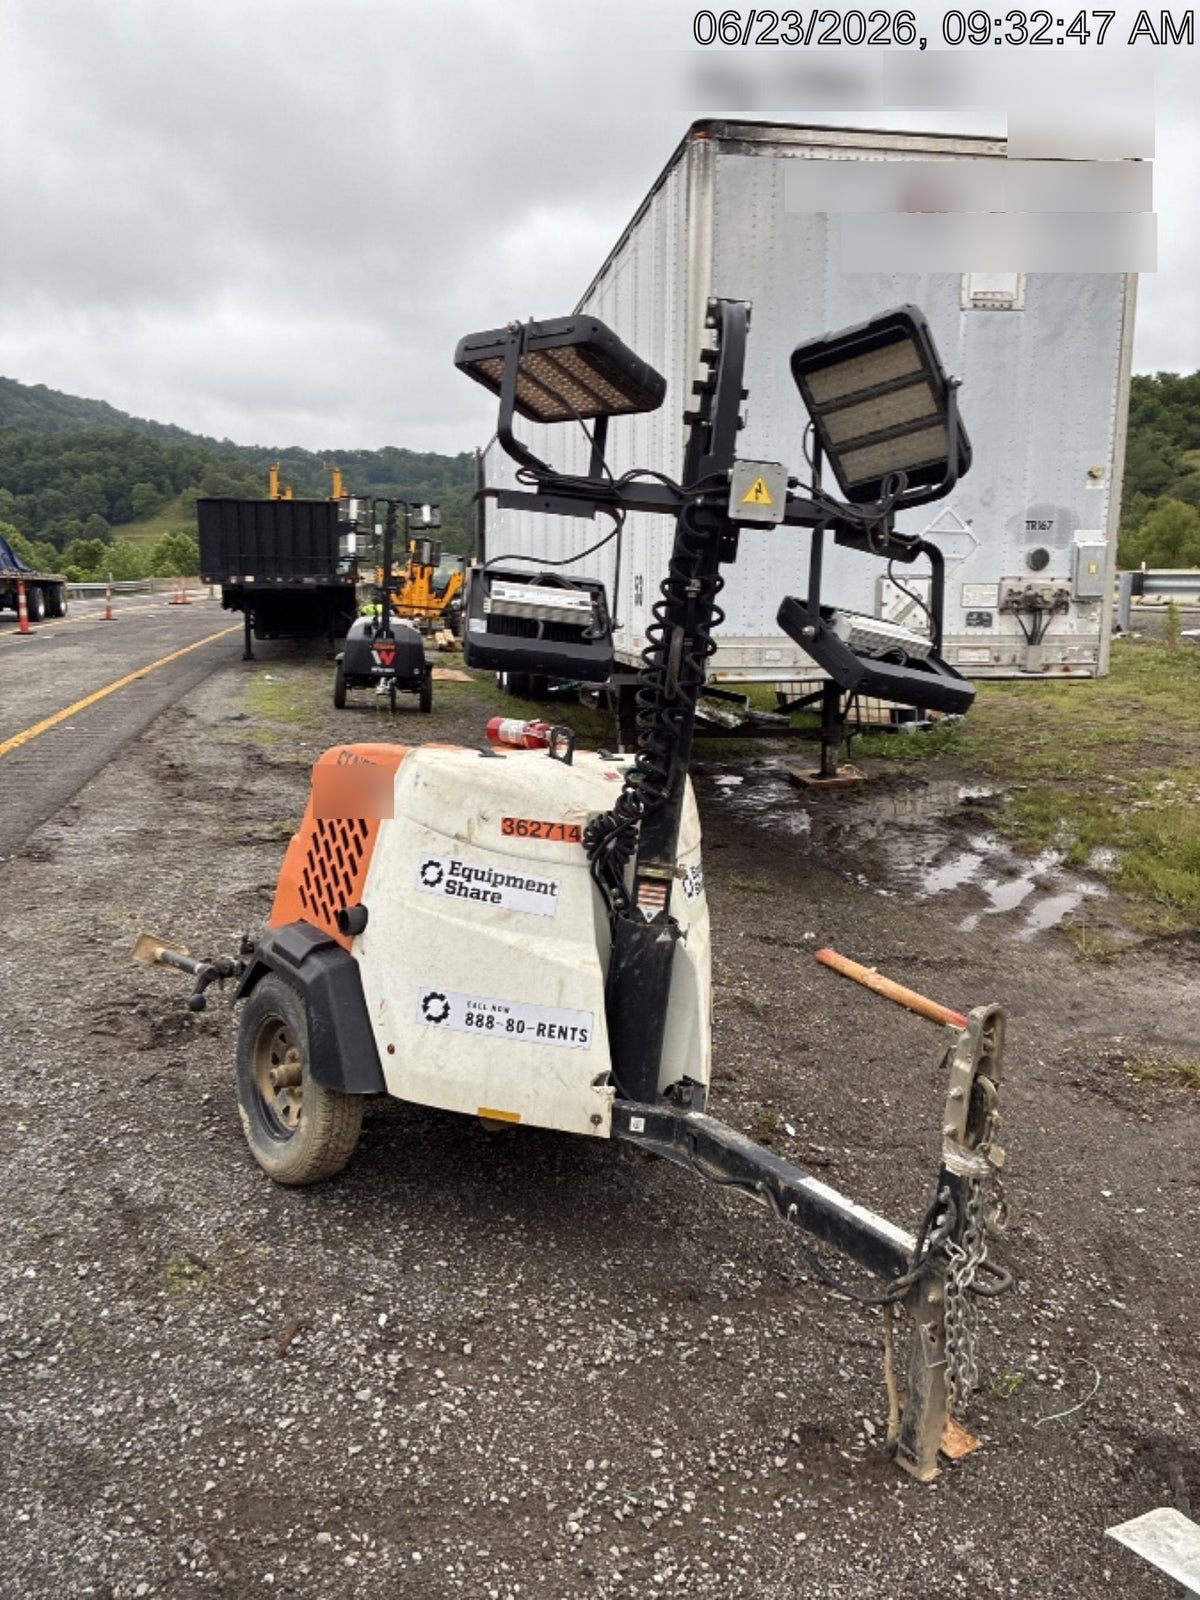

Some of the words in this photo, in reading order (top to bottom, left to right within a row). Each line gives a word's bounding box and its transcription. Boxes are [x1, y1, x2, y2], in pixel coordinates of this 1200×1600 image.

[1025, 520, 1054, 531] TR167
[502, 817, 581, 843] 362714
[448, 860, 558, 897] Equipment
[445, 879, 502, 904] Share
[466, 1000, 488, 1011] CALL
[491, 1004, 511, 1014] NOW
[465, 1012, 589, 1043] 888-80-RENTS
